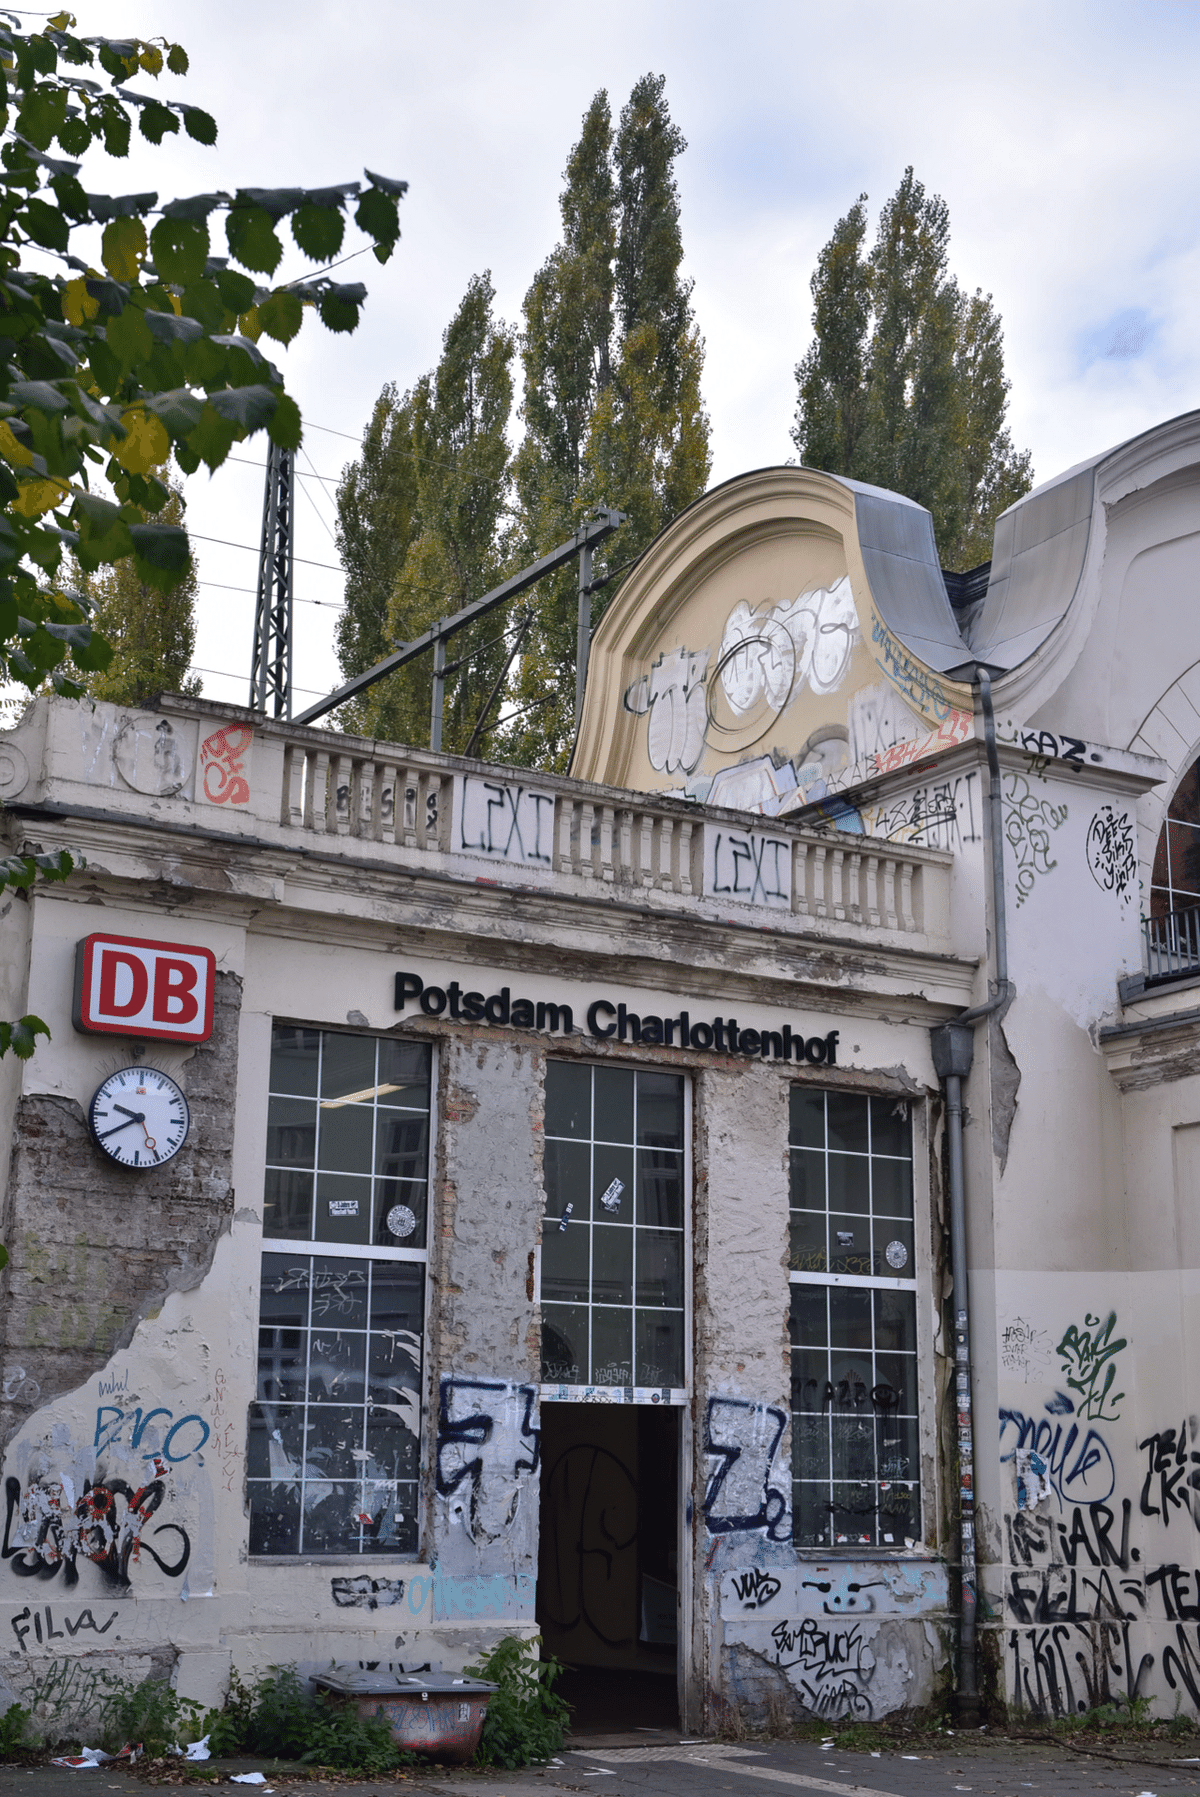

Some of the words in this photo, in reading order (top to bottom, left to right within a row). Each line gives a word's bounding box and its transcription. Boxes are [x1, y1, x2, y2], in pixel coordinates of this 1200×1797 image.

[99, 949, 198, 1025] DB
[394, 971, 573, 1034] Potsdam
[587, 999, 840, 1064] Charlottenhof
